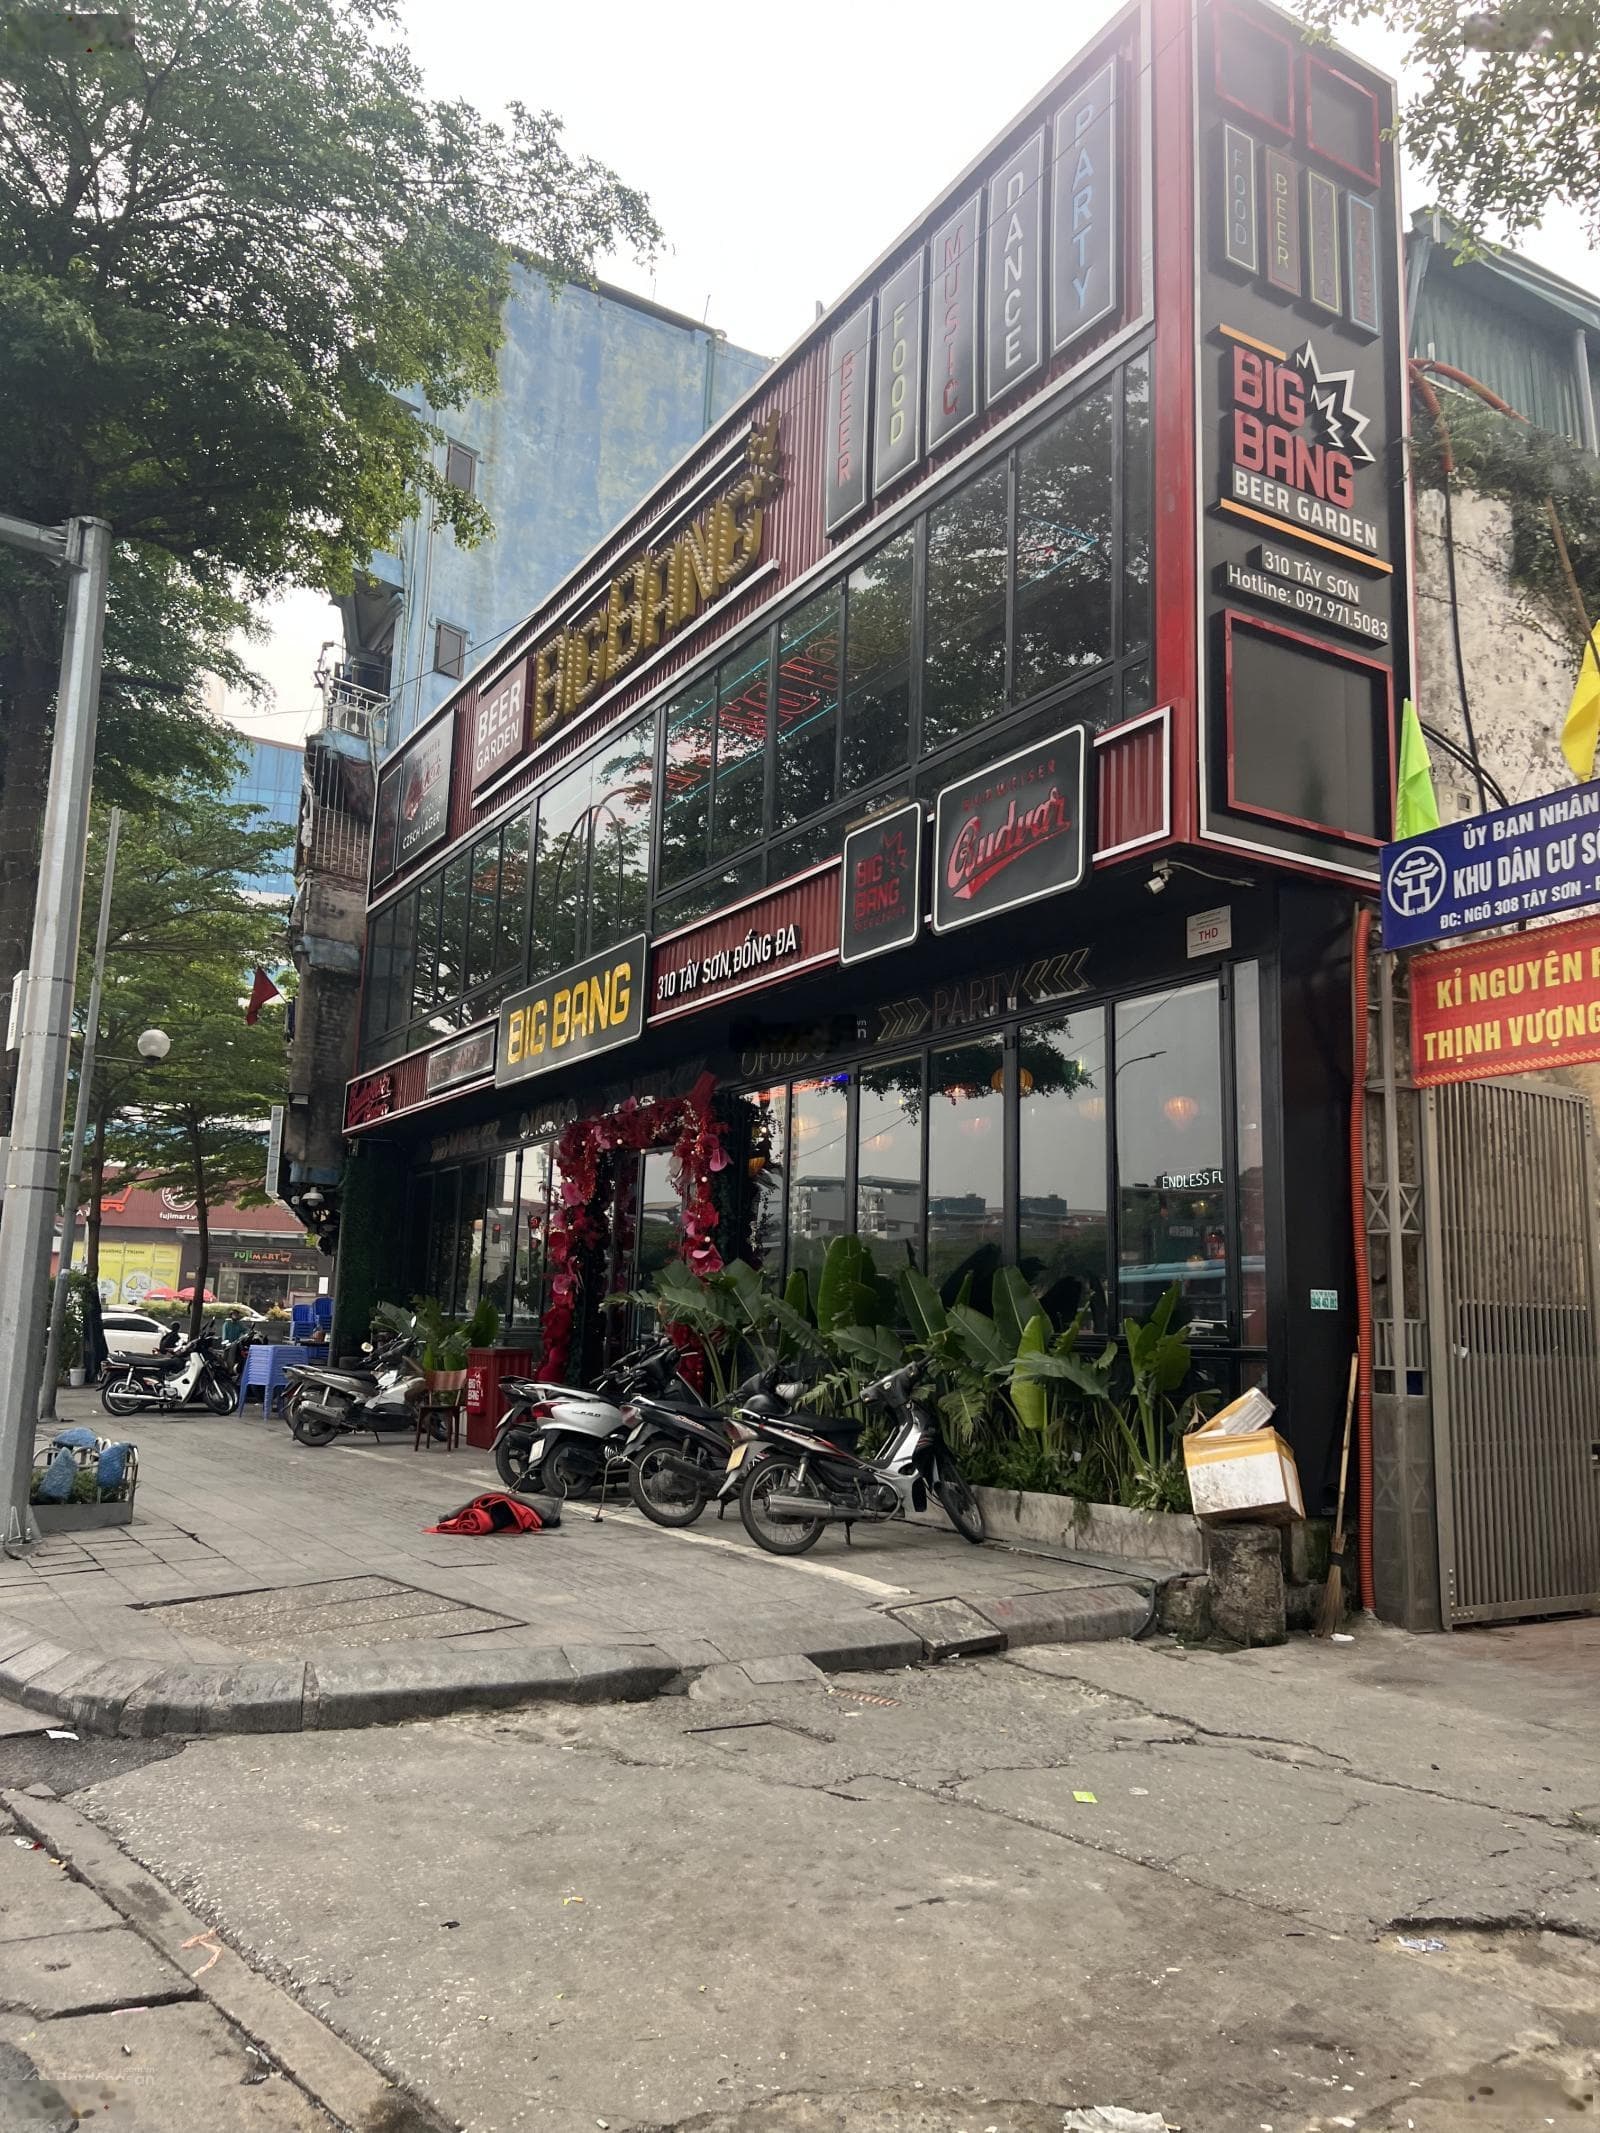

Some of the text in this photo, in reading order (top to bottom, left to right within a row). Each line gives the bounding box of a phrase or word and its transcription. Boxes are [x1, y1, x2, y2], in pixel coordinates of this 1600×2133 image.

[1072, 103, 1094, 311] PARTY
[1234, 147, 1248, 247] FOOD
[1275, 173, 1290, 269] BEER
[1003, 170, 1025, 370] DANCE
[942, 224, 965, 416] MUSIC
[889, 301, 908, 446] FOOD
[1233, 344, 1305, 427] BIG
[836, 349, 854, 488] BEER
[1233, 408, 1354, 510] BANG
[1235, 470, 1378, 549] BEER GARDEN
[1228, 564, 1389, 640] Hotline: 097.971.5083
[1264, 550, 1360, 603] 310 TÂY SƠN
[476, 718, 520, 772] GARDEN
[478, 679, 521, 746] BEER
[402, 811, 441, 850] CZECH LAGER
[1463, 791, 1600, 850] ỦY BAN NHÂN
[854, 877, 900, 918] BANG
[855, 854, 884, 888] BIG
[1453, 860, 1492, 899] KHU
[1497, 845, 1541, 888] DÂN
[1546, 833, 1578, 874] CƯ
[1198, 927, 1219, 942] THD
[1440, 912, 1461, 930] ĐC:
[1464, 901, 1491, 924] NGÕ
[1494, 897, 1519, 916] 308
[1522, 888, 1548, 909] TÂY
[1551, 880, 1582, 902] SƠN
[656, 970, 676, 1000] 310
[679, 958, 699, 993] TÂY
[733, 928, 771, 973] ĐỐNG
[775, 923, 797, 957] ĐA
[1436, 967, 1463, 1009] KỈ
[1469, 948, 1583, 1004] NGUYÊN
[507, 998, 548, 1065] BIG
[551, 961, 632, 1049] BANG
[934, 967, 1020, 1026] PARTY
[1424, 1019, 1502, 1063] THỊNH
[1162, 1172, 1210, 1189] ENDLESS
